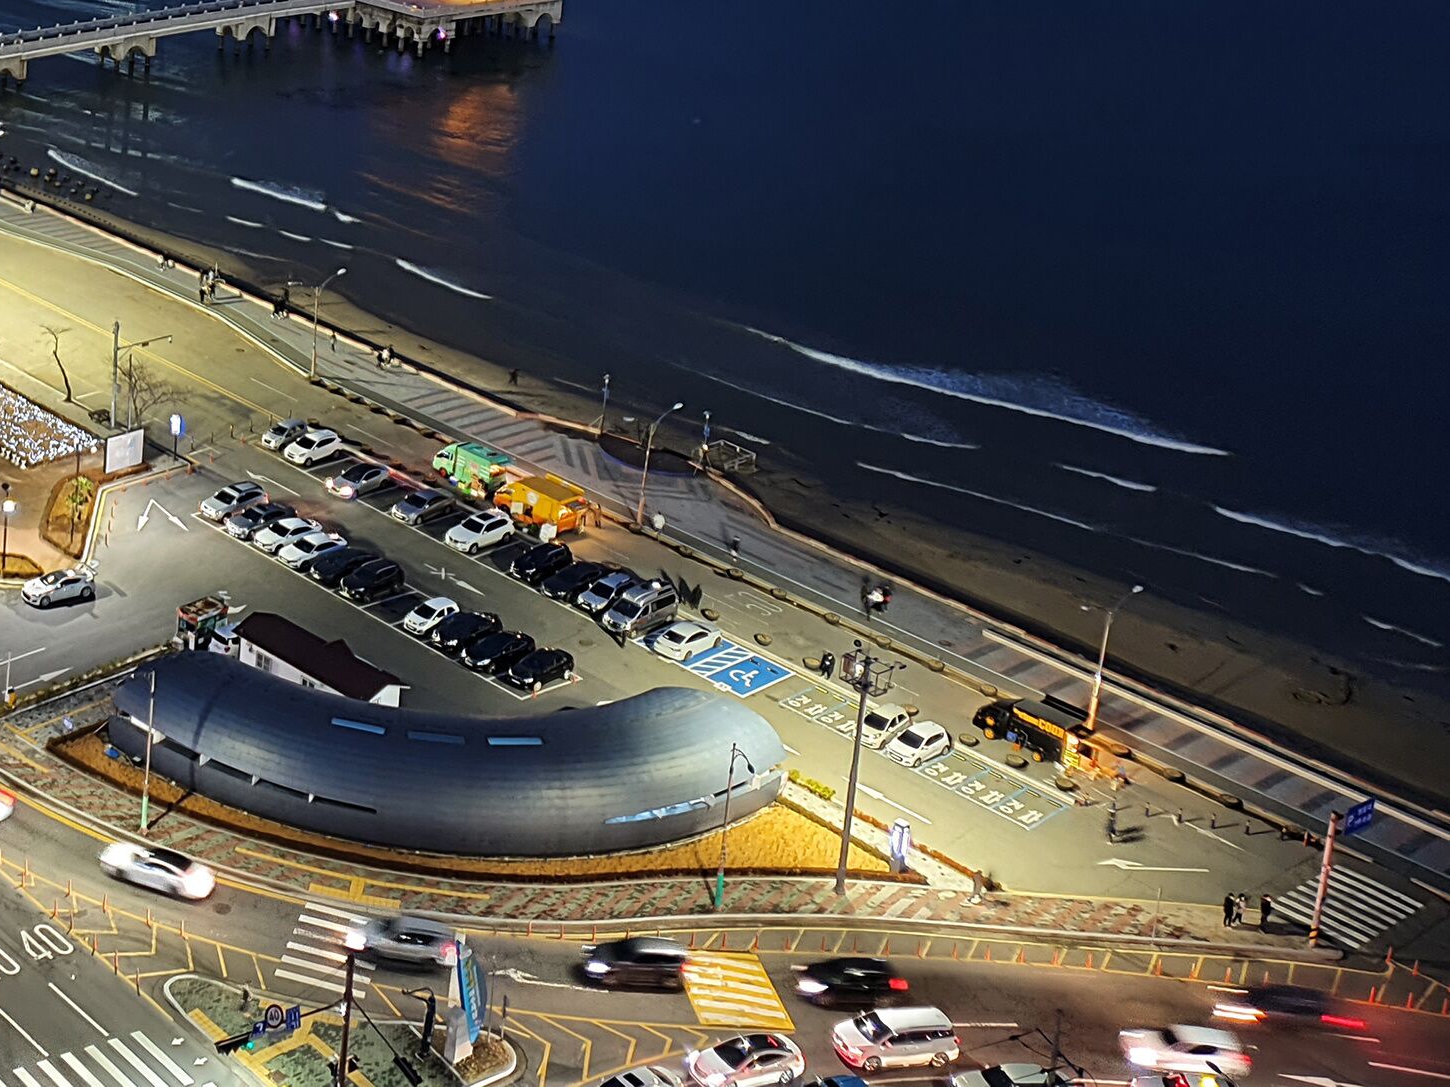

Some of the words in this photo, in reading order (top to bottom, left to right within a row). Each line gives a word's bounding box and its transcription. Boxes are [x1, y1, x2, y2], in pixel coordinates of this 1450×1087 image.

[924, 762, 967, 786] 경차
[961, 779, 1005, 805] 경차
[999, 798, 1044, 824] 경차
[20, 924, 74, 959] 40
[269, 1010, 280, 1022] 40
